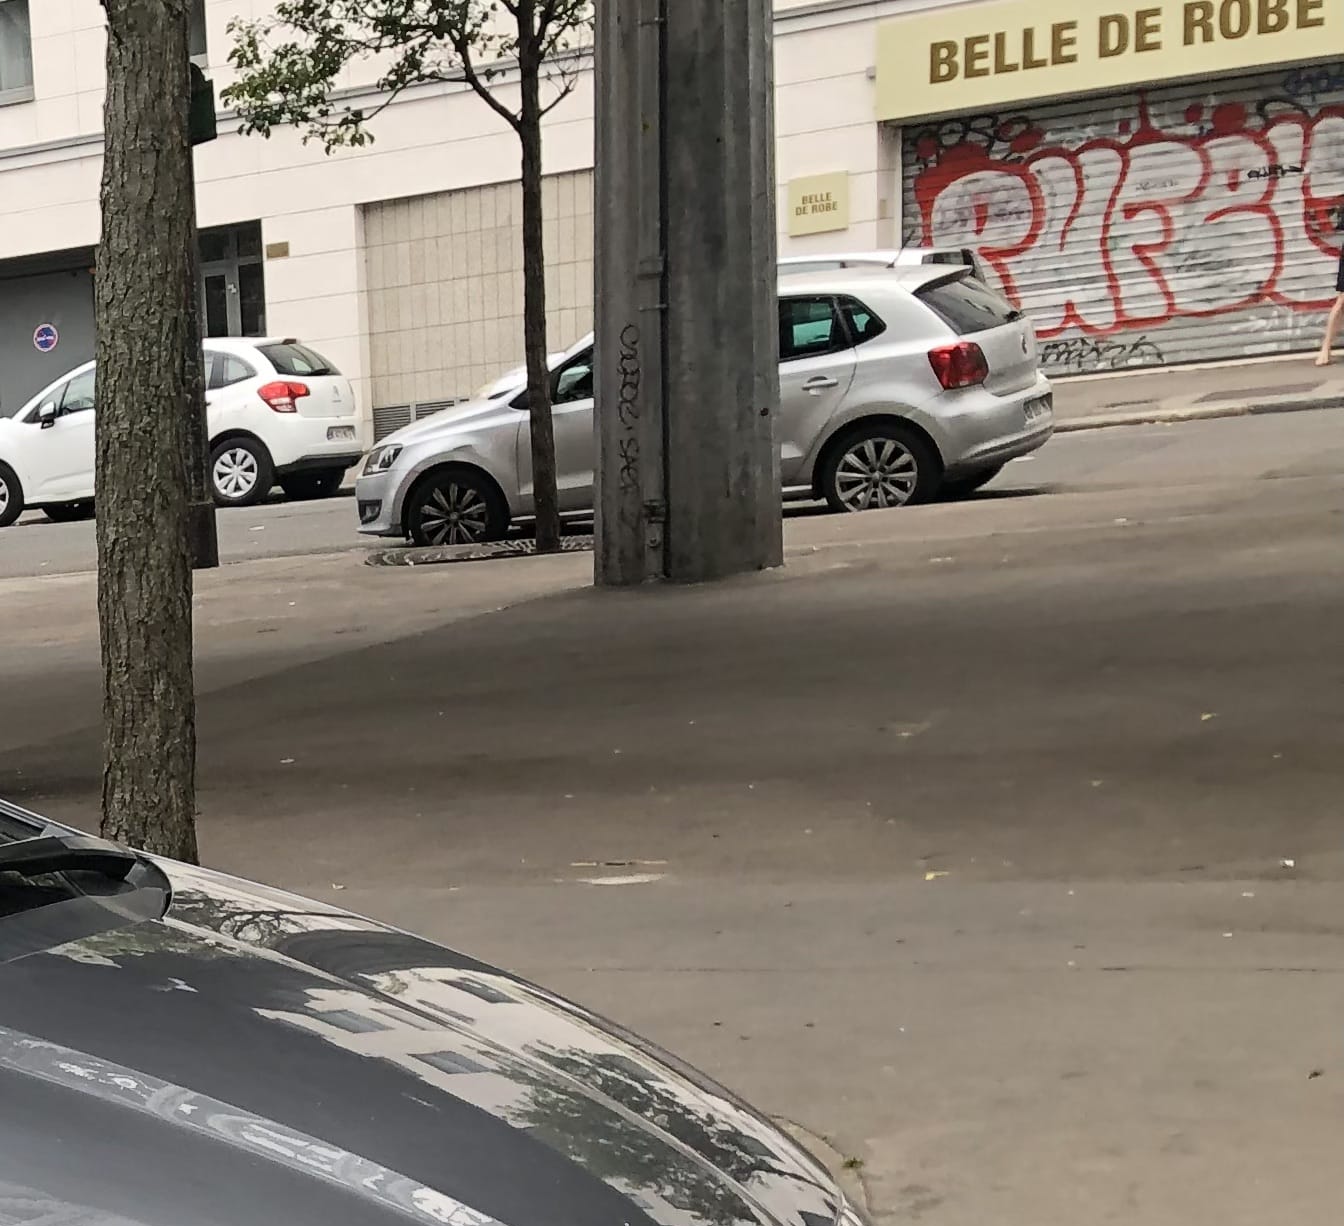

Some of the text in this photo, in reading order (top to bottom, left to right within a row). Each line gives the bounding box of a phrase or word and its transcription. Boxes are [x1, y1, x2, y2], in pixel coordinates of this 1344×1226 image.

[929, 0, 1326, 84] BELLE DE ROBE
[801, 192, 833, 205] BELLE
[795, 201, 838, 216] DE ROBE
